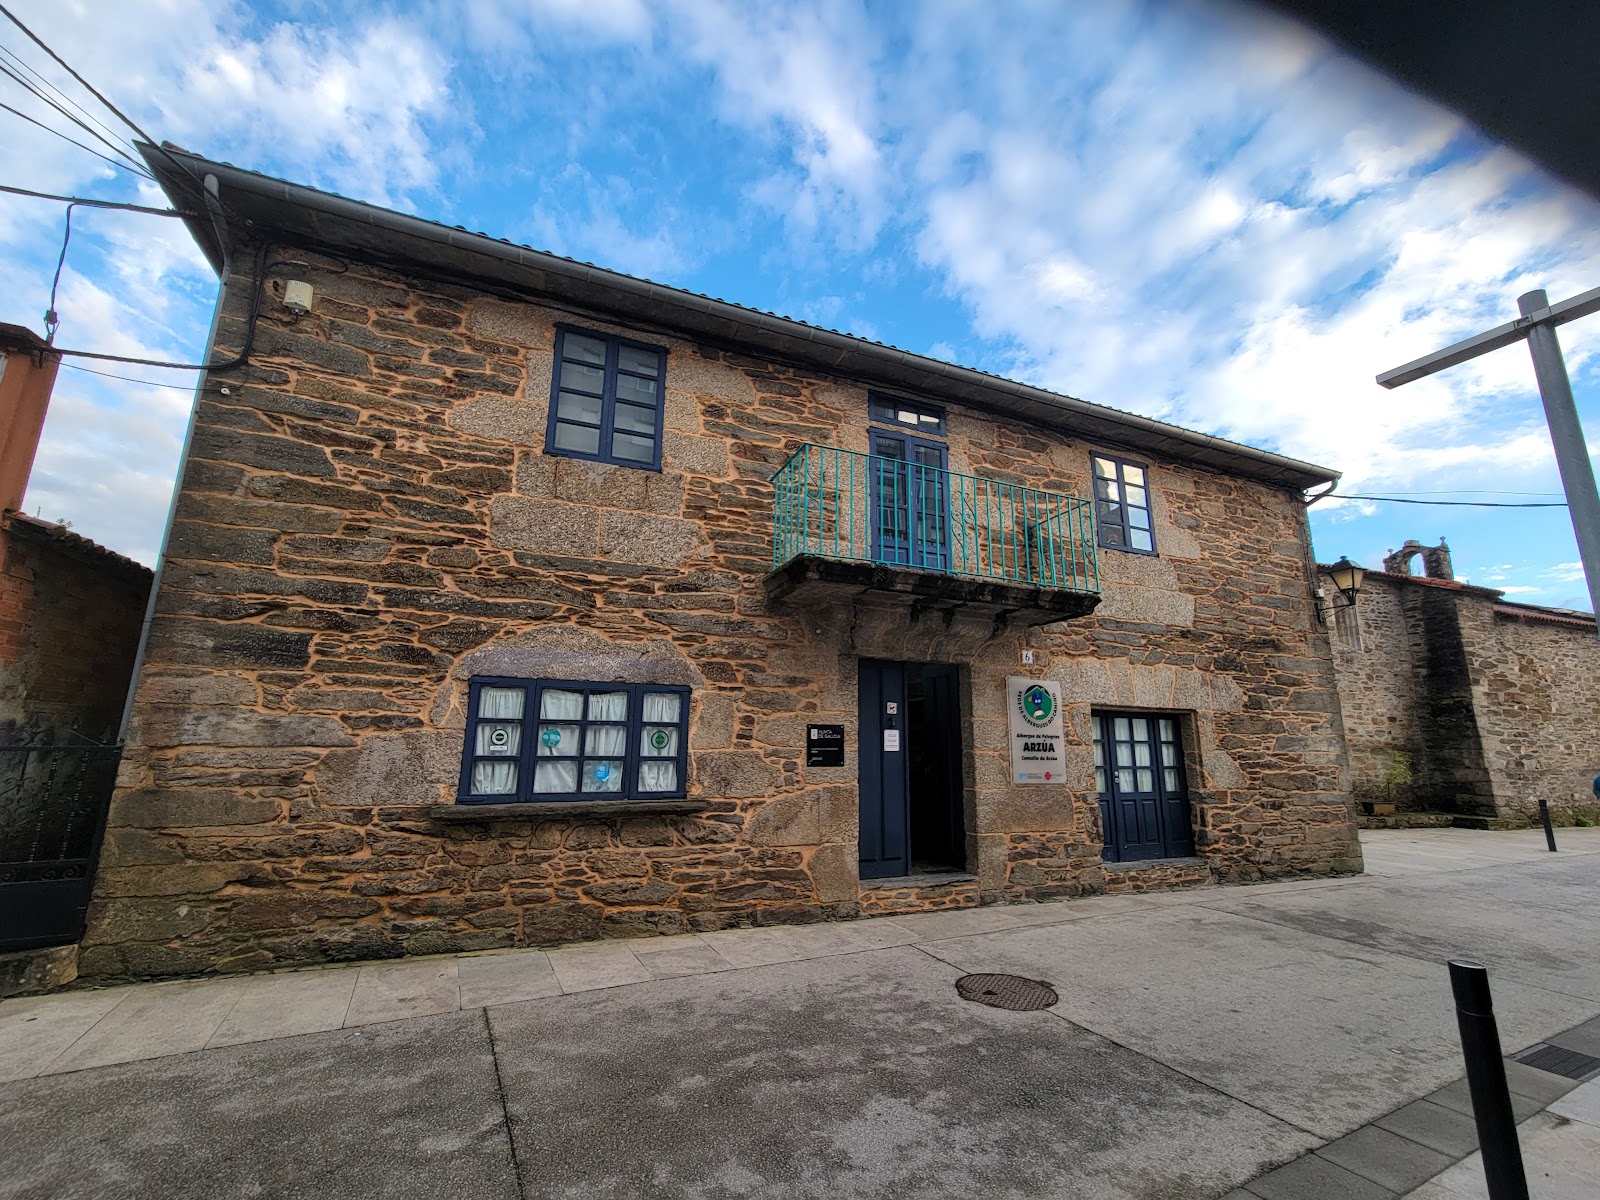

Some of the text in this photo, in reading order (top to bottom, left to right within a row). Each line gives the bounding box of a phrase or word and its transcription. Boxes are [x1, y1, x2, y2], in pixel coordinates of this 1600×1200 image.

[1025, 652, 1030, 662] 6
[1022, 715, 1048, 728] ALBERGUES
[1023, 740, 1055, 752] ARZÚA
